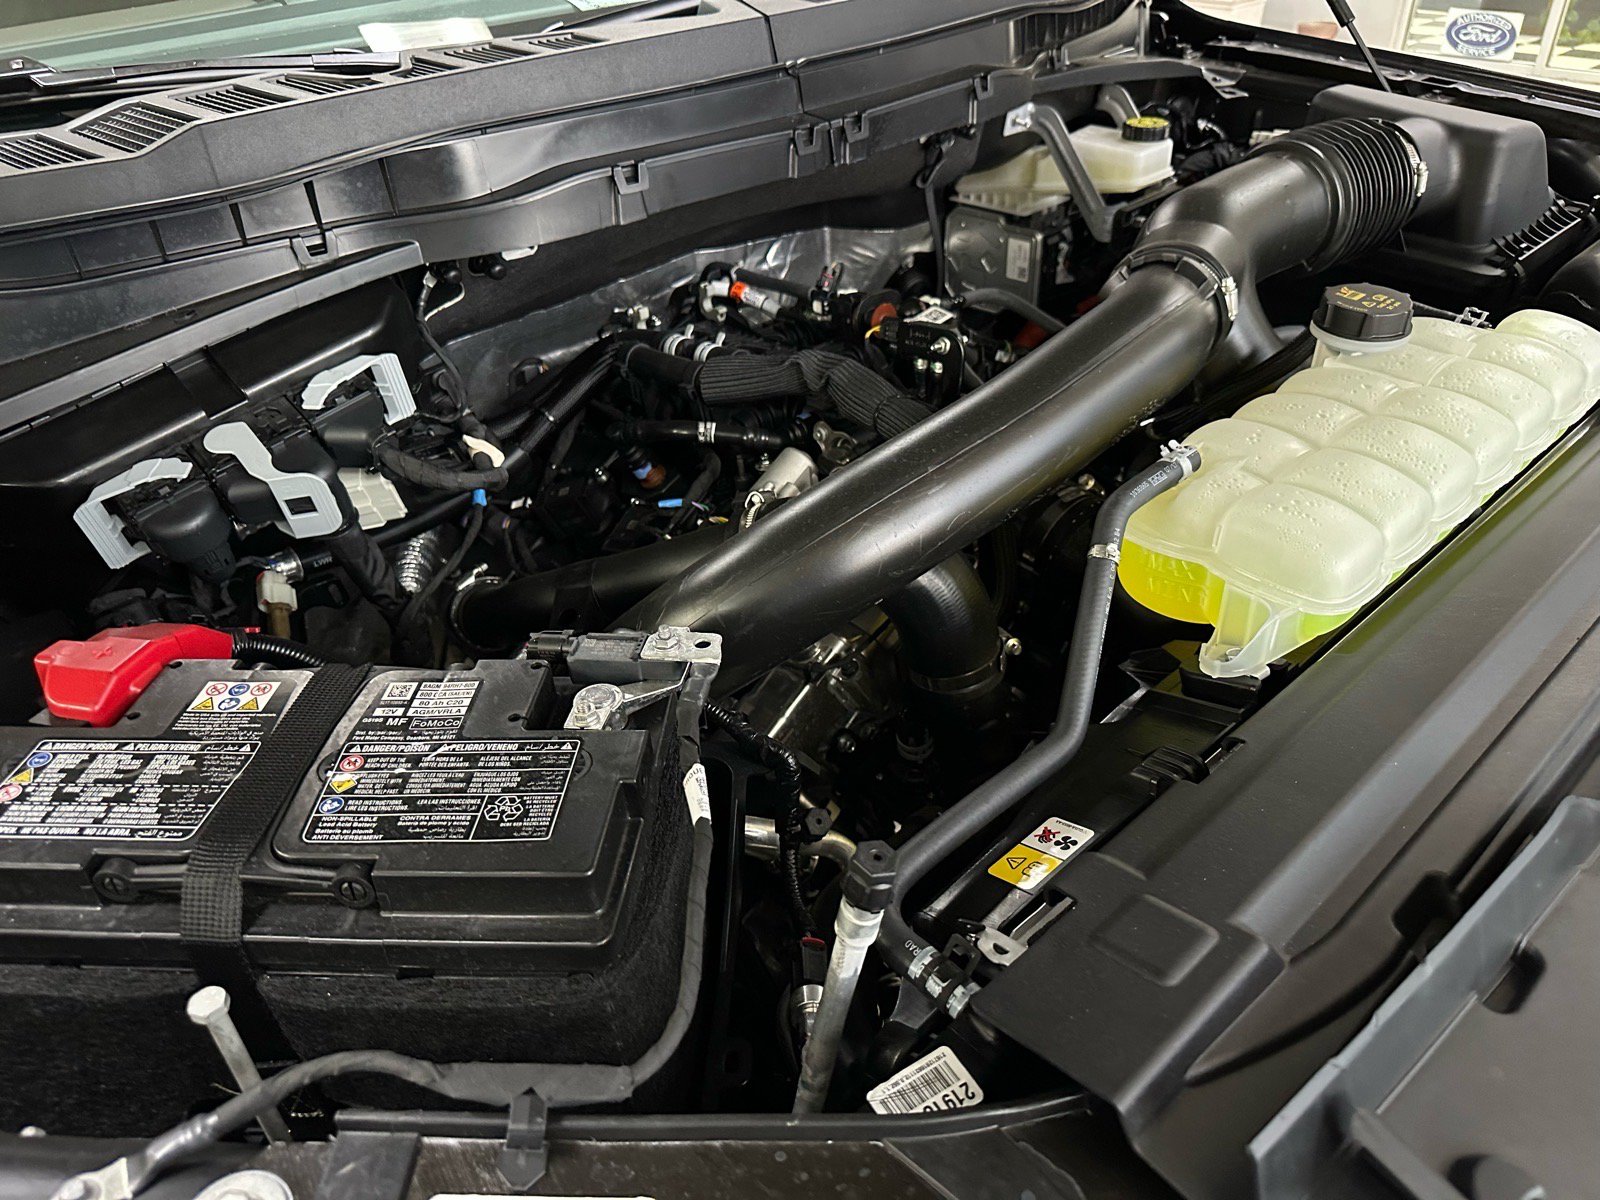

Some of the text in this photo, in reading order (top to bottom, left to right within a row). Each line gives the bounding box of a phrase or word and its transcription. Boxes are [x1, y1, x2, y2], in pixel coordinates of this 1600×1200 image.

[1457, 13, 1512, 30] AUTHORIZED
[1459, 24, 1502, 43] Ford
[1456, 44, 1496, 57] SERVICE
[386, 718, 409, 726] MF
[412, 719, 460, 727] FoMoCo
[53, 743, 201, 751] DANGER/POISON PELIGRO/VENENO
[361, 744, 518, 752] DANGER/POISON PELIGRO/VENENO
[48, 827, 80, 835] OUVRIR.
[107, 827, 131, 835] ABRA.
[904, 939, 922, 956] RAD
